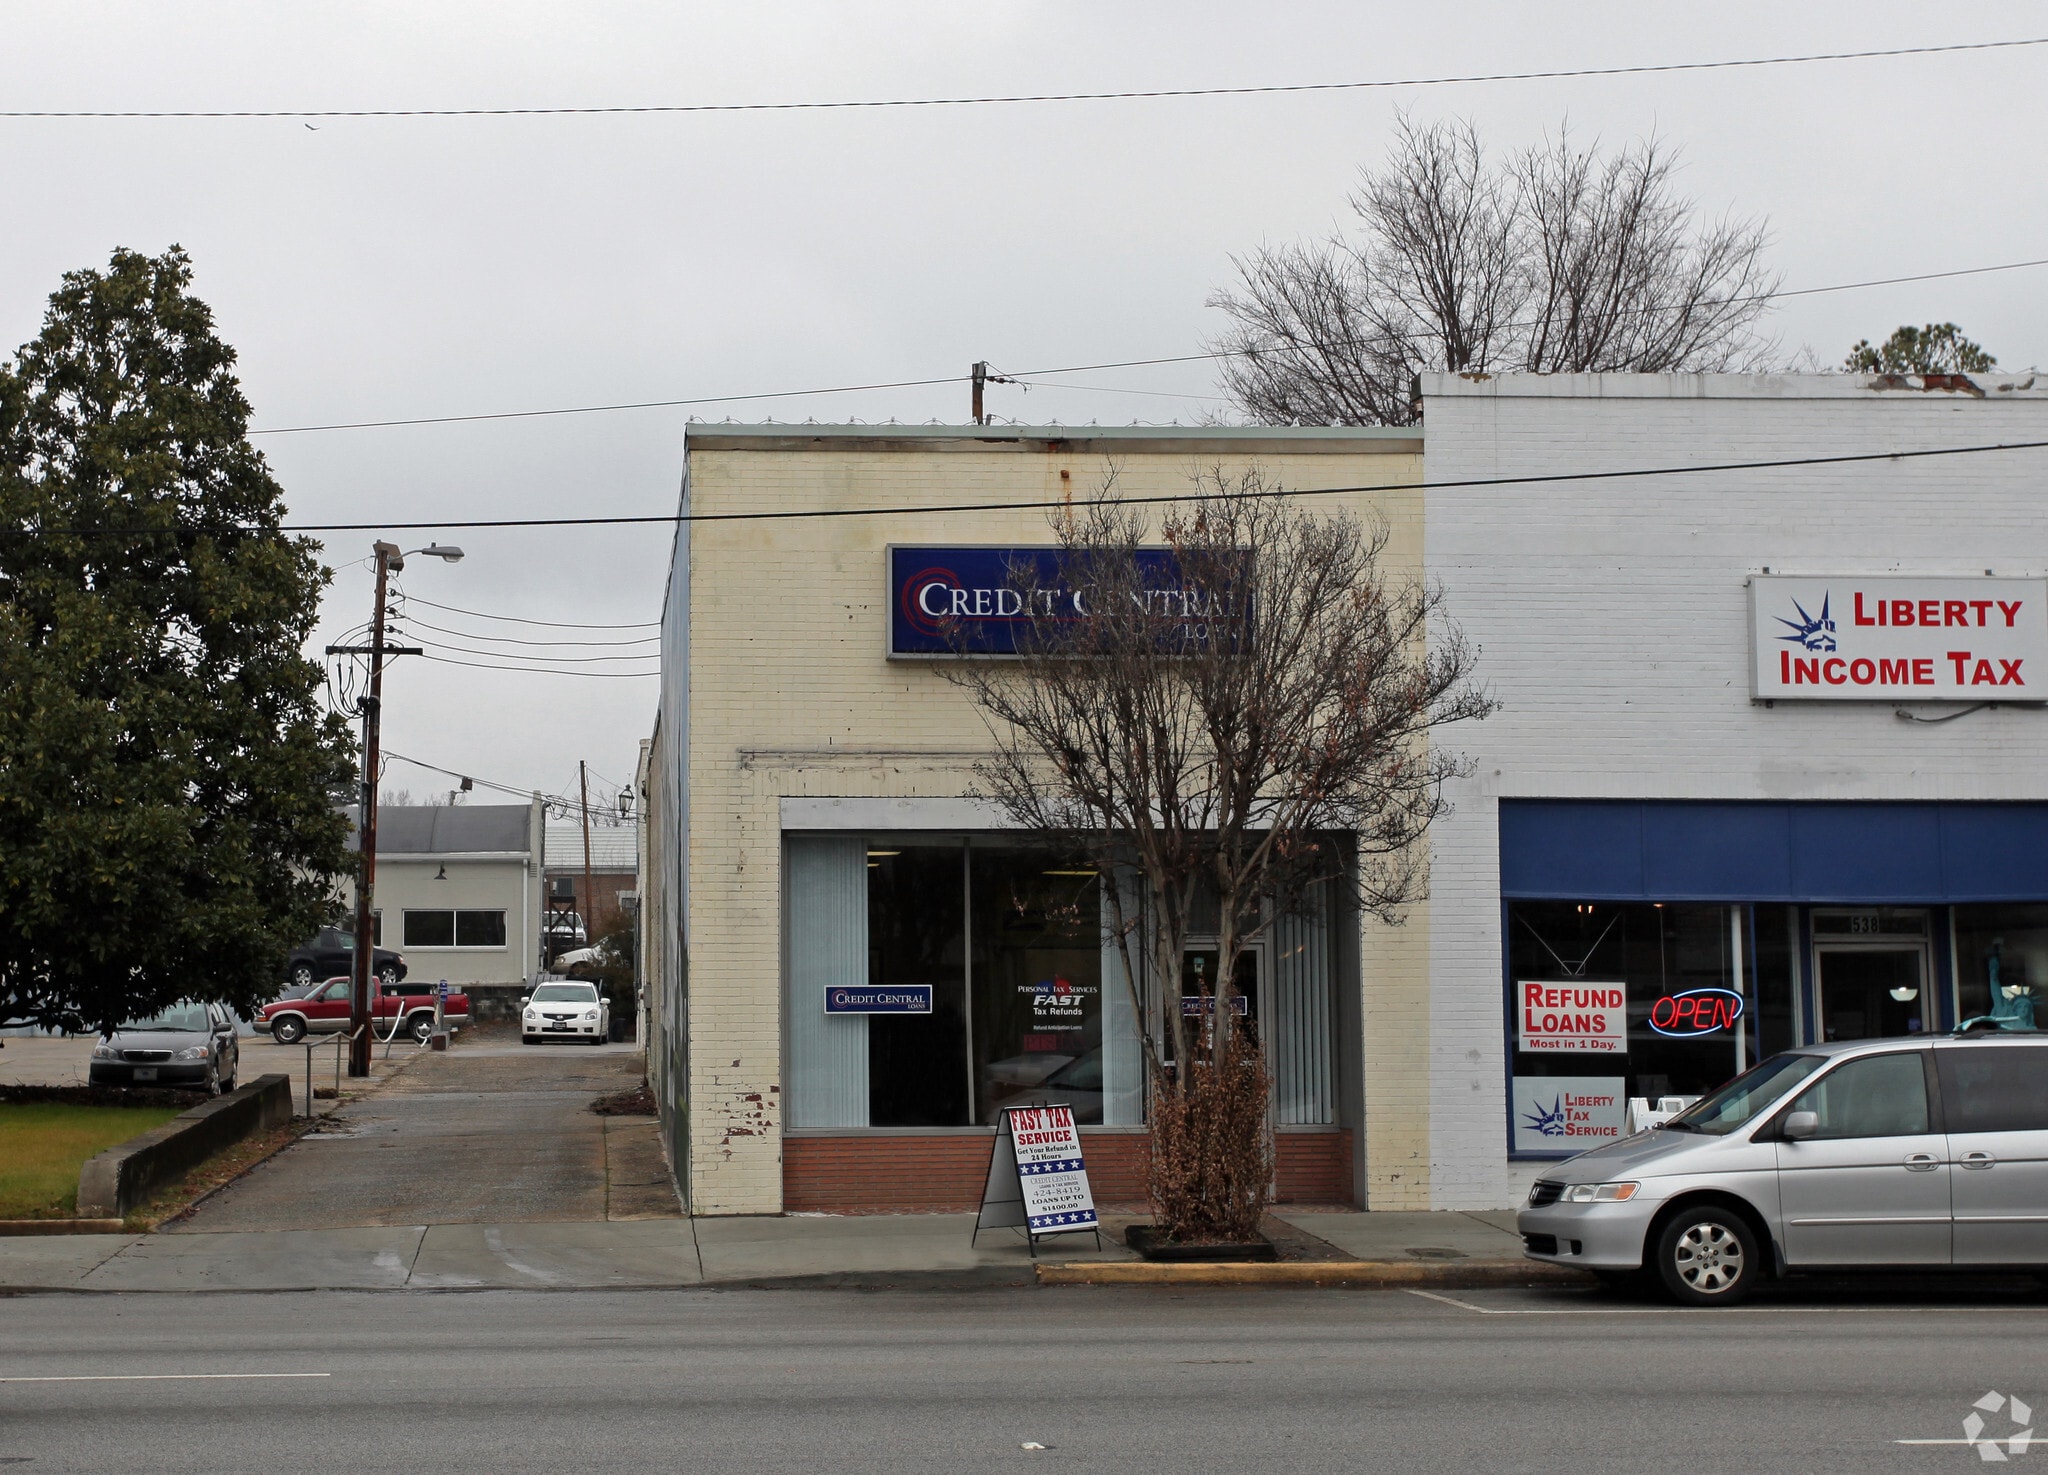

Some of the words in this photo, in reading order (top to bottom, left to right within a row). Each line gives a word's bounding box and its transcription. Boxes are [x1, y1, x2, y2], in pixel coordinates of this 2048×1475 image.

[918, 583, 1061, 617] CREDIT
[1073, 583, 1240, 617] CNTRA
[1854, 592, 2023, 628] LIBERTY
[1780, 650, 1935, 685] INCOME
[1946, 651, 2026, 686] TAX
[1853, 916, 1878, 933] 538
[1017, 985, 1050, 993] PERSONAL
[1053, 985, 1065, 993] TAX
[1068, 985, 1098, 993] SERVICES
[1525, 983, 1623, 1009] REFUND
[836, 993, 876, 1004] CREDIT
[877, 993, 926, 1004] CENTRAL
[1033, 995, 1084, 1006] FAST
[1033, 1007, 1047, 1015] Tax
[1050, 1007, 1083, 1015] Refunds
[1652, 996, 1737, 1029] OPEN
[1525, 1009, 1606, 1033] LOANS
[1529, 1039, 1560, 1049] Most
[1564, 1039, 1575, 1049] in
[1580, 1039, 1587, 1049] 1
[1591, 1039, 1617, 1050] Day.
[1565, 1093, 1615, 1107] LIBERTY
[1010, 1108, 1042, 1131] FAST
[1046, 1107, 1072, 1128] TAX
[1565, 1107, 1590, 1121] TAX
[1565, 1122, 1618, 1136] SERVICE
[1018, 1130, 1072, 1145] SERVICE
[1045, 1145, 1069, 1153] Refund
[1033, 1186, 1081, 1197] 424-8419
[1032, 1197, 1059, 1205] LOANS
